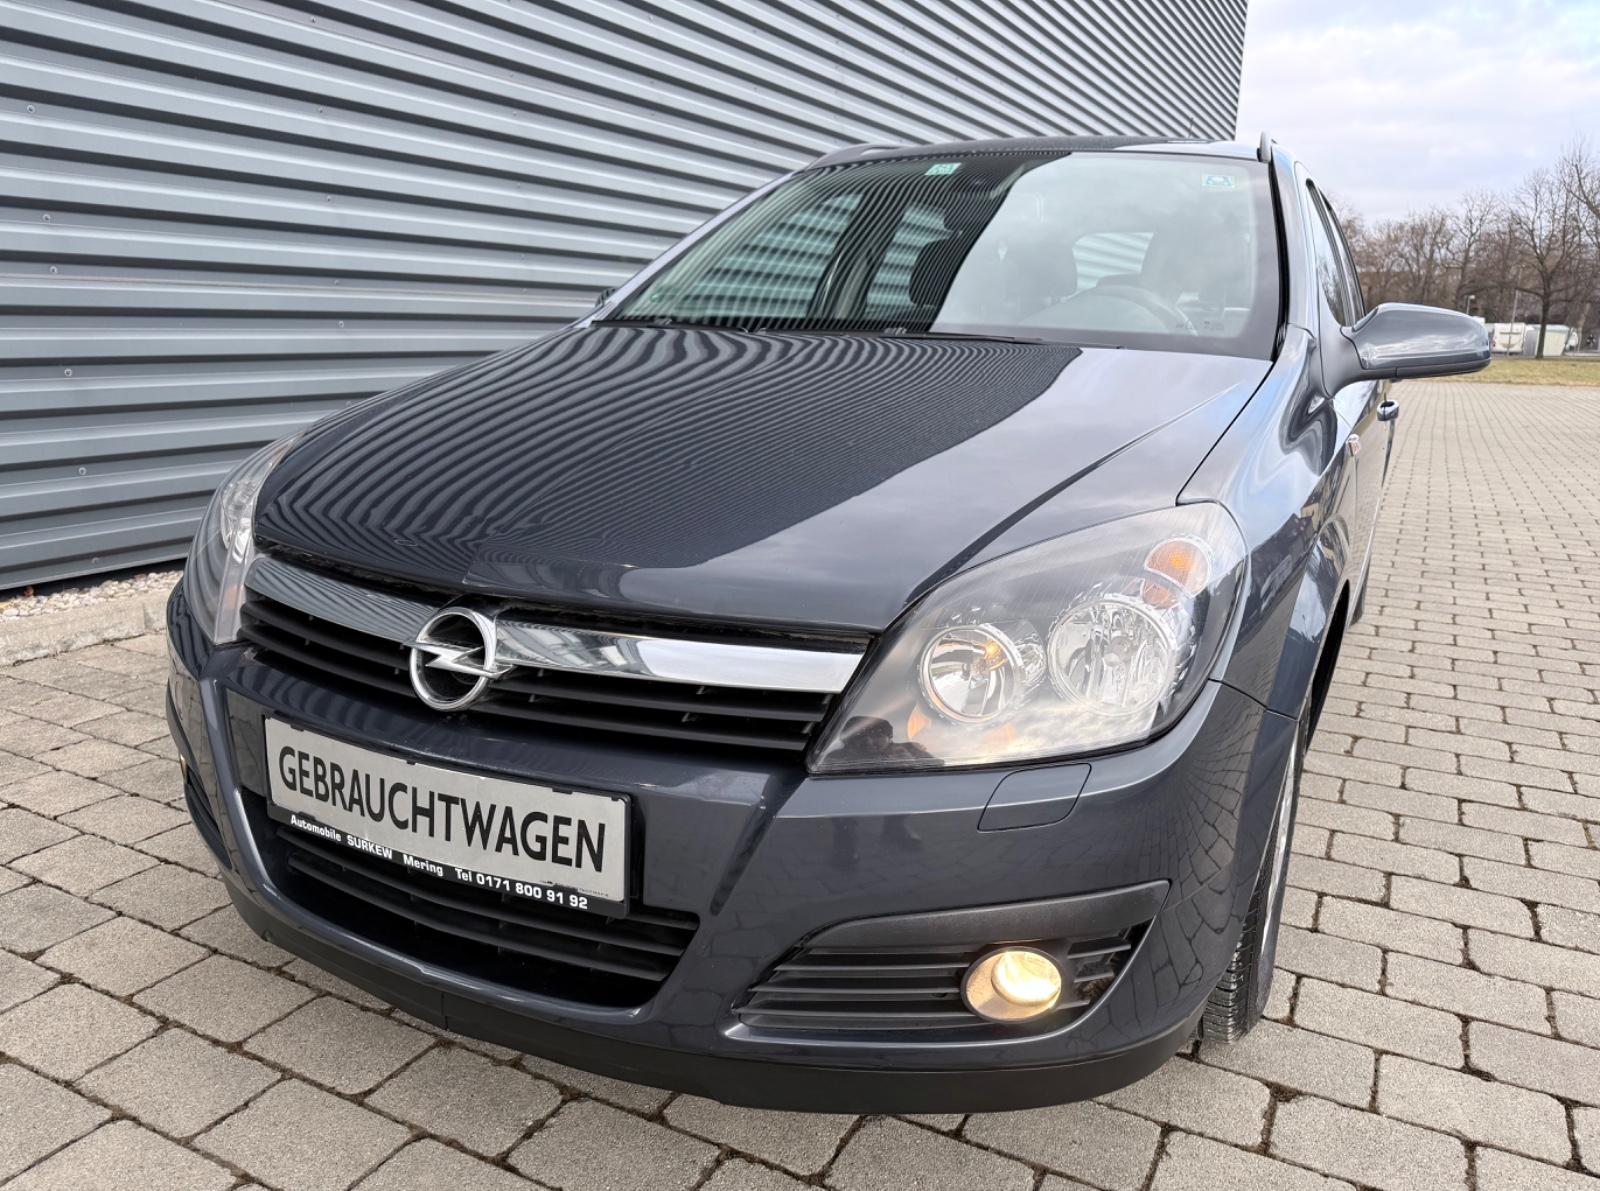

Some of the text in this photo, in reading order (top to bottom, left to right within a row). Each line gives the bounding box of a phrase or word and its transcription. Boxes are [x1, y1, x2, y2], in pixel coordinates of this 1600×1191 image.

[278, 745, 606, 873] GEBRAUCHTWAGEN
[290, 814, 342, 842] Automobile
[347, 834, 393, 859] SURKEW
[403, 853, 443, 877] Mering
[455, 867, 472, 883] Tel
[476, 873, 510, 892] 0171
[515, 882, 542, 899] 800
[546, 889, 564, 905] 91
[569, 894, 588, 910] 92
